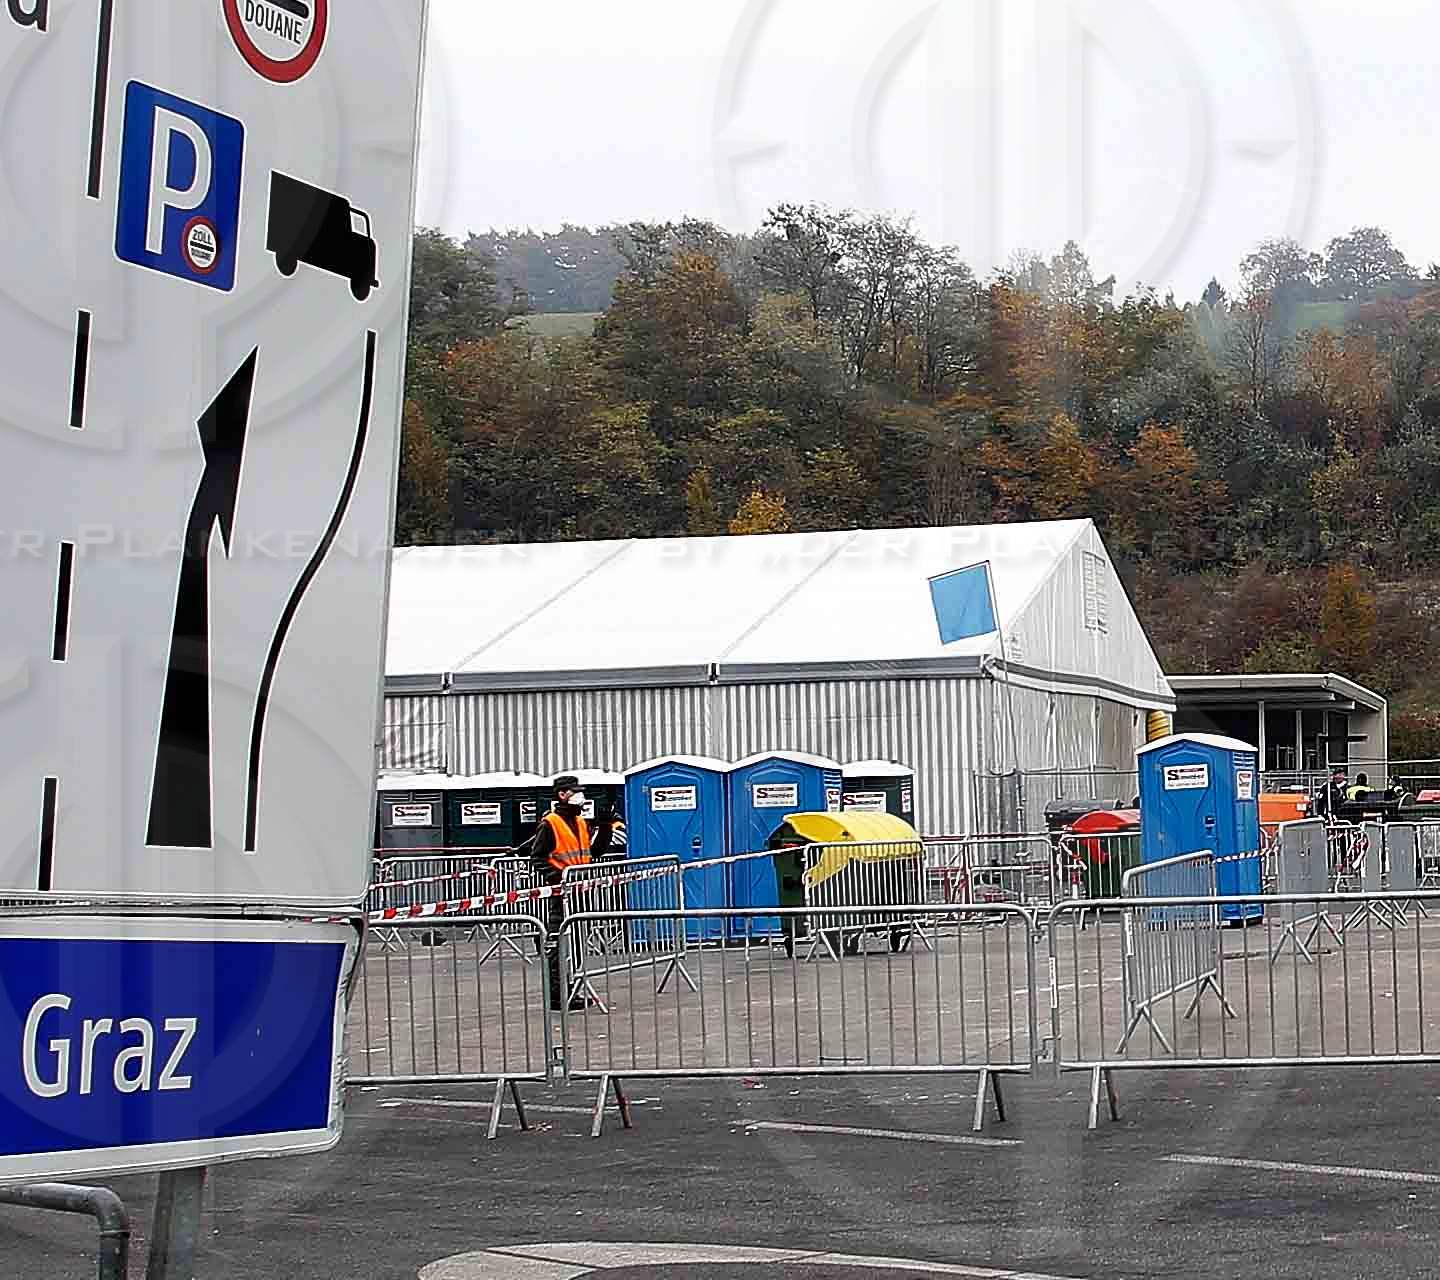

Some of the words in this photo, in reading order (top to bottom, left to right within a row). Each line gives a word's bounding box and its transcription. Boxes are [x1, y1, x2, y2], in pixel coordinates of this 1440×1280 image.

[244, 0, 303, 45] DOUANE
[145, 105, 213, 255] P
[21, 992, 198, 1099] Graz
